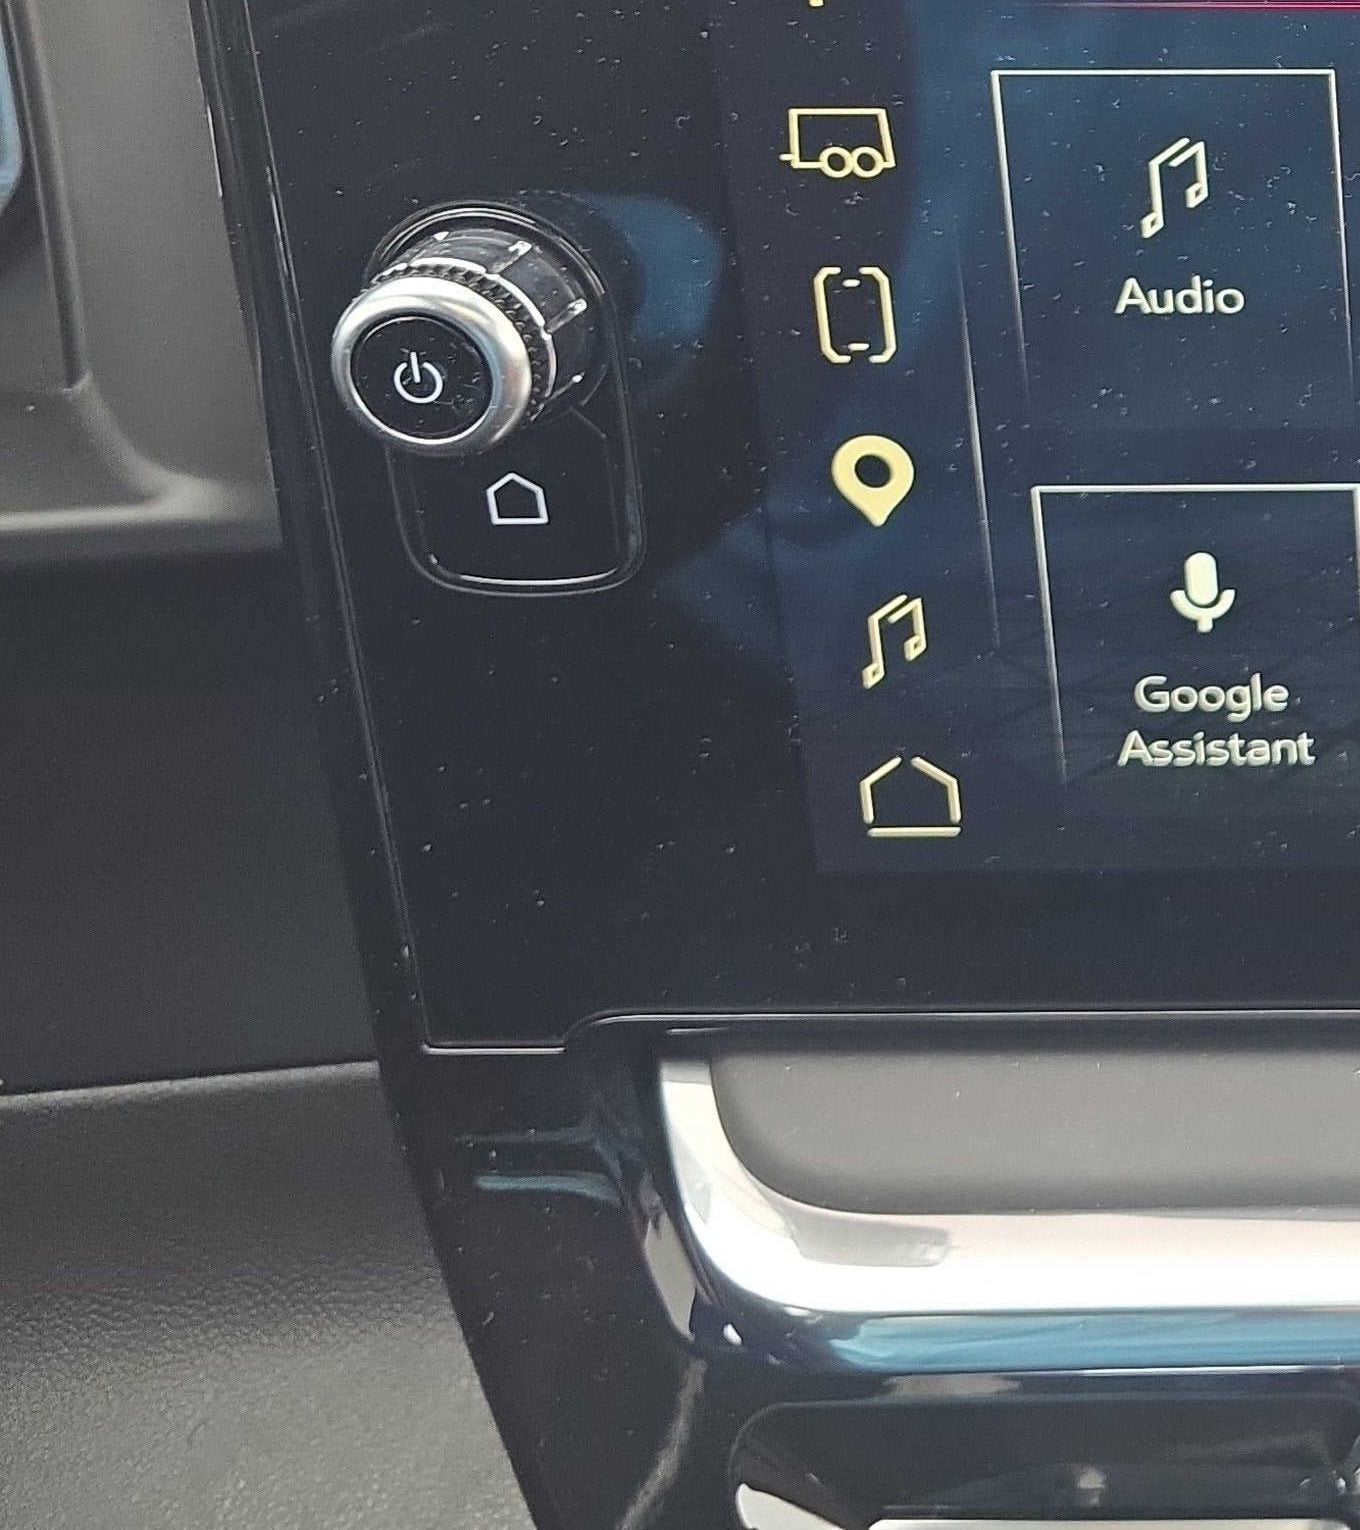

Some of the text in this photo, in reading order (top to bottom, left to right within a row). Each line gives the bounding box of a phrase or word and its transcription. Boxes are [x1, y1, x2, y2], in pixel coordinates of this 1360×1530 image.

[1114, 274, 1246, 315] Audio
[1133, 671, 1290, 723] Google
[1116, 729, 1317, 768] Assistant
